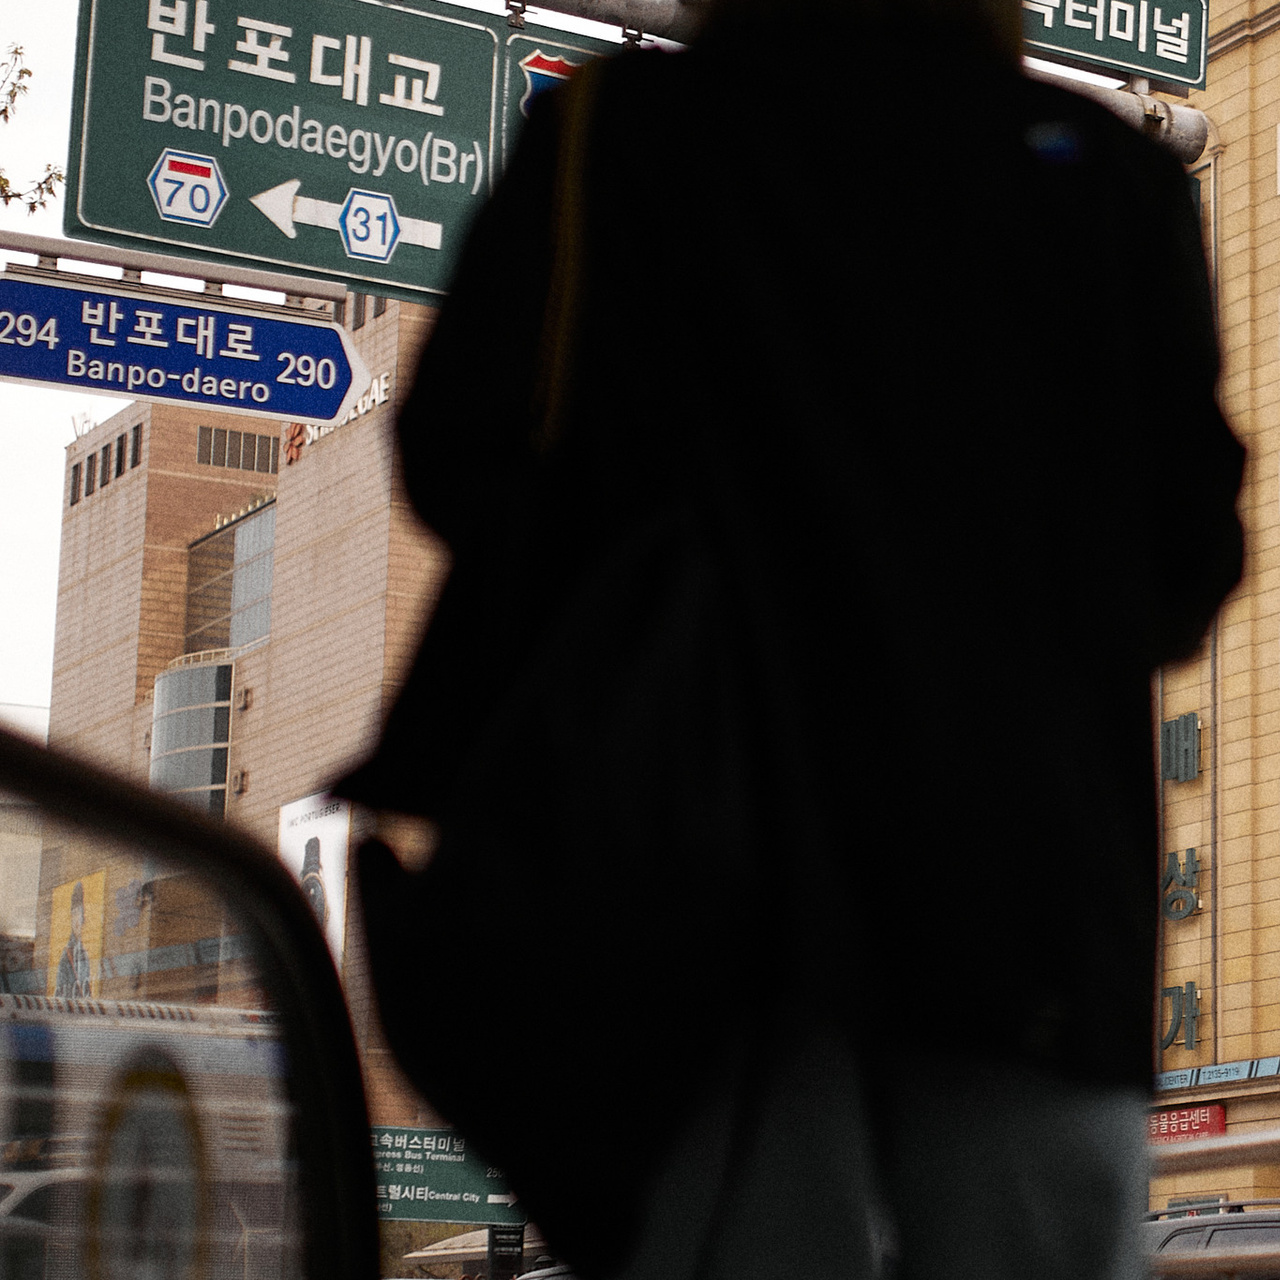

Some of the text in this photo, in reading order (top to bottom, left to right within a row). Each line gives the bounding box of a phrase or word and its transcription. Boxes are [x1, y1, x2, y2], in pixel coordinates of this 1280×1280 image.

[142, 74, 485, 194] Banpodaegyo(Br)
[163, 177, 211, 216] 70
[351, 205, 390, 248] 31
[0, 309, 60, 352] 294
[81, 299, 261, 362] 반포대로
[66, 348, 271, 404] Banpo-daero
[276, 351, 337, 390] 290
[404, 1150, 423, 1160] Bus
[425, 1151, 466, 1163] Terminal
[376, 1184, 481, 1204] 트럴시티 Central City
